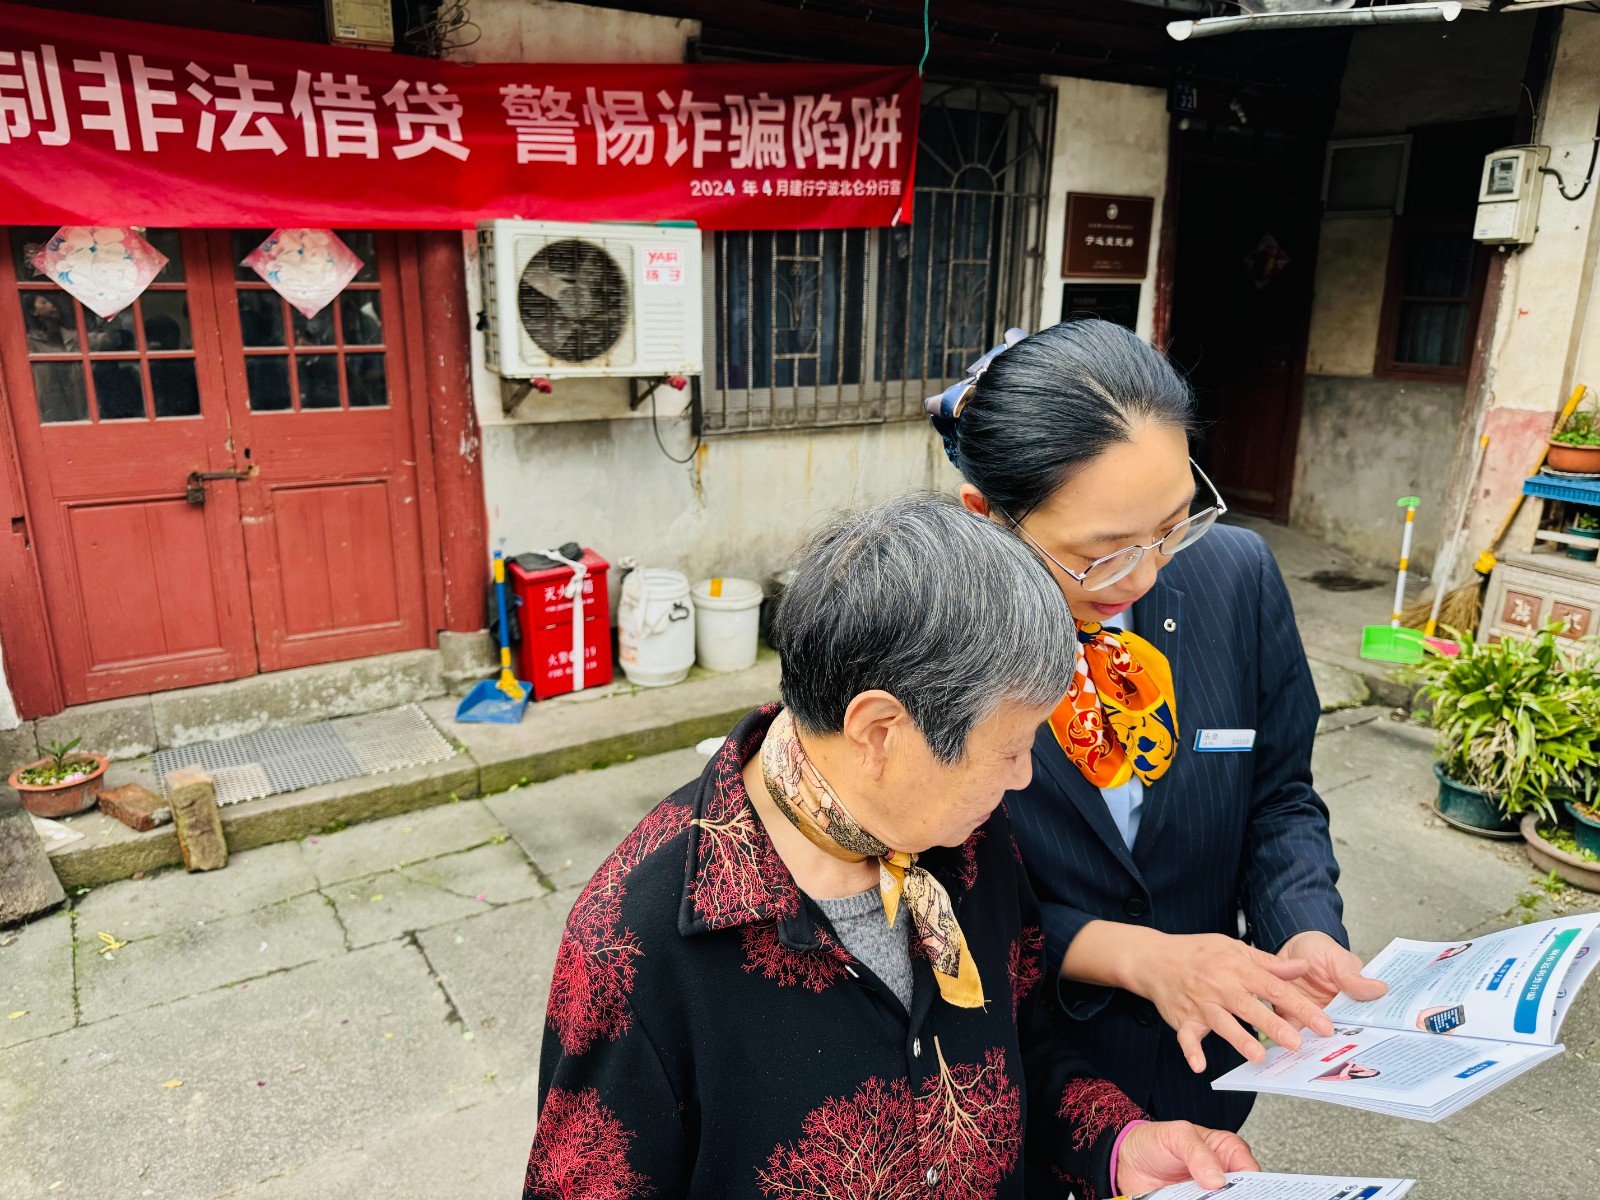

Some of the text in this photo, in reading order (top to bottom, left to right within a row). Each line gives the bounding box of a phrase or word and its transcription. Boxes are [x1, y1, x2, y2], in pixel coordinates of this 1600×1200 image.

[0, 44, 902, 170] 制非法借贷 警惕诈骗陷阱
[690, 180, 735, 196] 2024
[742, 180, 758, 196] 年
[762, 179, 773, 196] 4
[544, 579, 594, 603] 灭火箱
